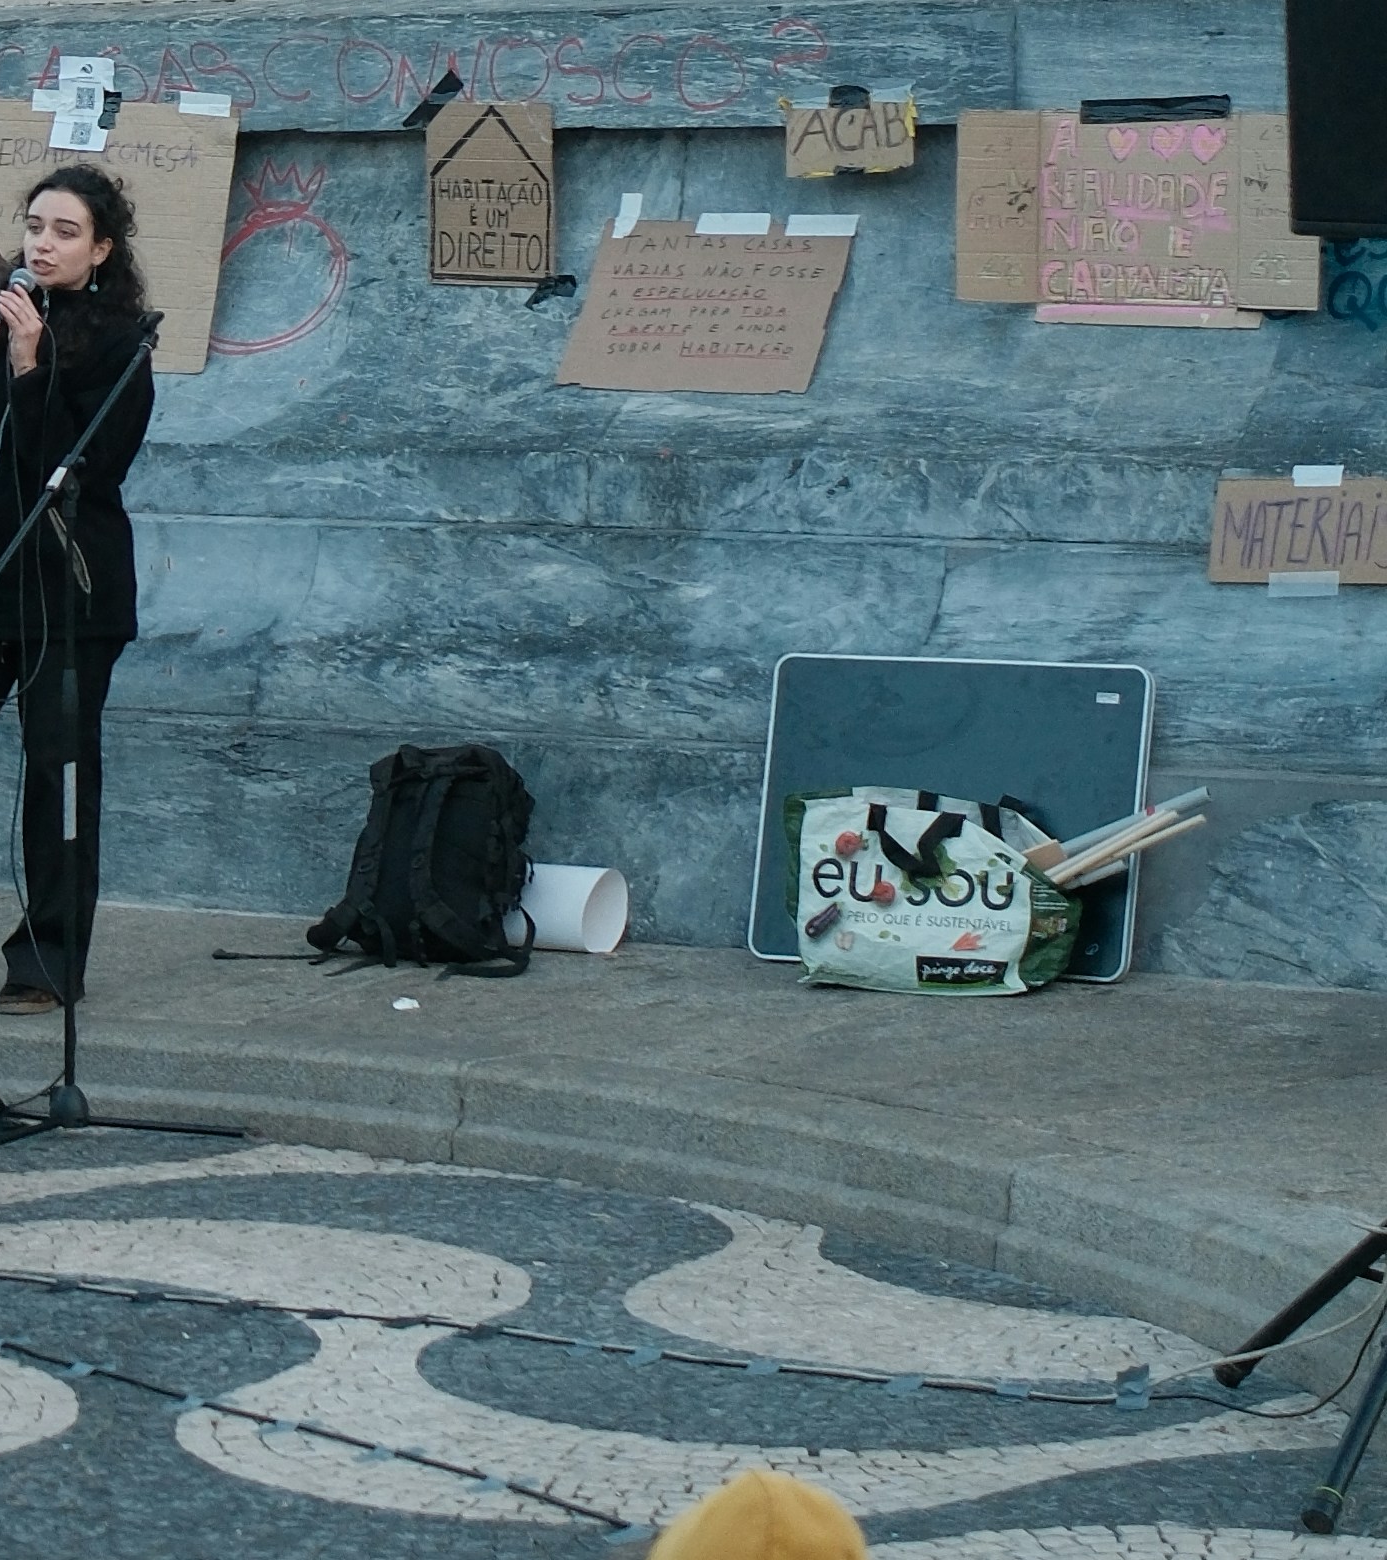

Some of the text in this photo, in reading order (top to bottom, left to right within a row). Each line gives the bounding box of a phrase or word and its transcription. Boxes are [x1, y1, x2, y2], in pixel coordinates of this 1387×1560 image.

[791, 102, 908, 157] ACAB
[1047, 120, 1077, 164] A
[437, 178, 543, 213] HABITAÇÃO
[1041, 162, 1228, 220] REALIDADE
[486, 208, 509, 229] UM
[1043, 211, 1139, 253] NÃO
[439, 230, 543, 273] DIREITO
[622, 234, 813, 254] TANTAS CASAS
[611, 261, 826, 279] VAZIAS NÃO FOSSE
[601, 306, 788, 320] CHEGAM PARA TODA
[734, 324, 787, 334] AINDA
[607, 340, 794, 357] SOBRA HABITAÇÃO
[812, 856, 884, 903] eu
[847, 910, 1014, 932] PELO QUE É SUSTENTÁVEL
